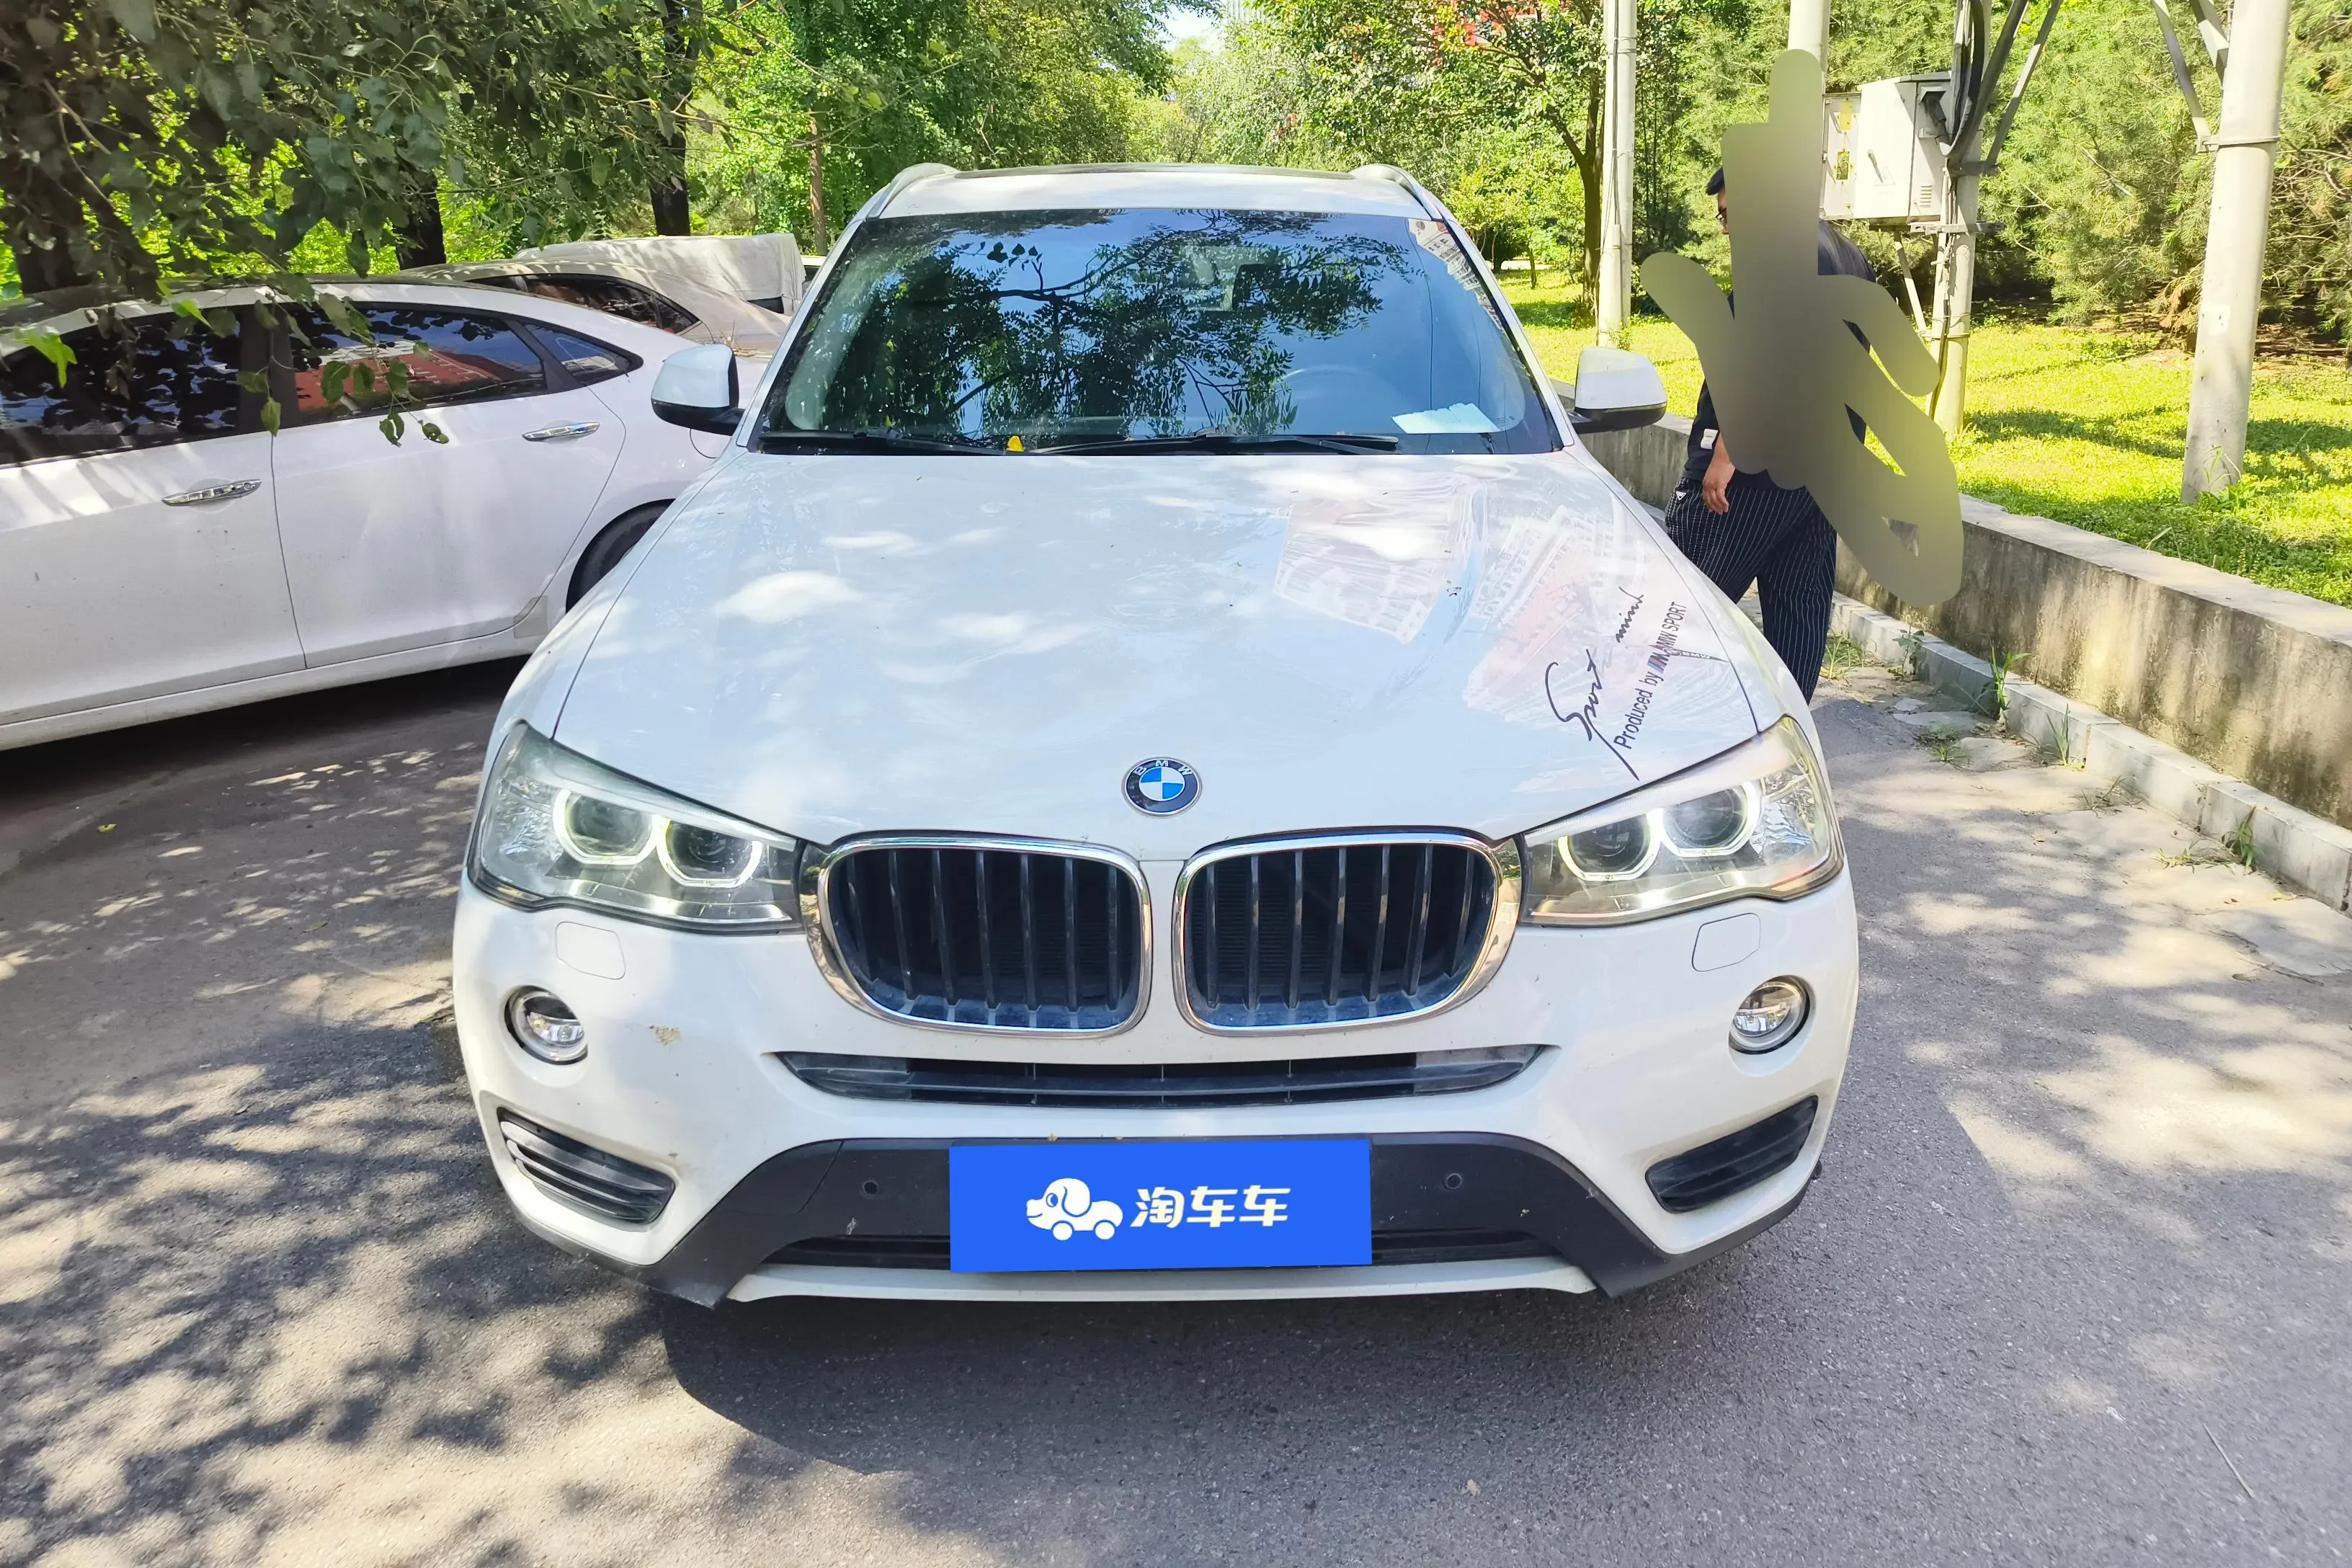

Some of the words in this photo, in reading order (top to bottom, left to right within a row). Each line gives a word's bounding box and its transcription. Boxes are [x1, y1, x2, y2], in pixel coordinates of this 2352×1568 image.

[1613, 687, 1653, 749] Produced
[1639, 671, 1664, 686] by
[1662, 602, 1687, 631] SPORT
[1133, 759, 1193, 775] BMW
